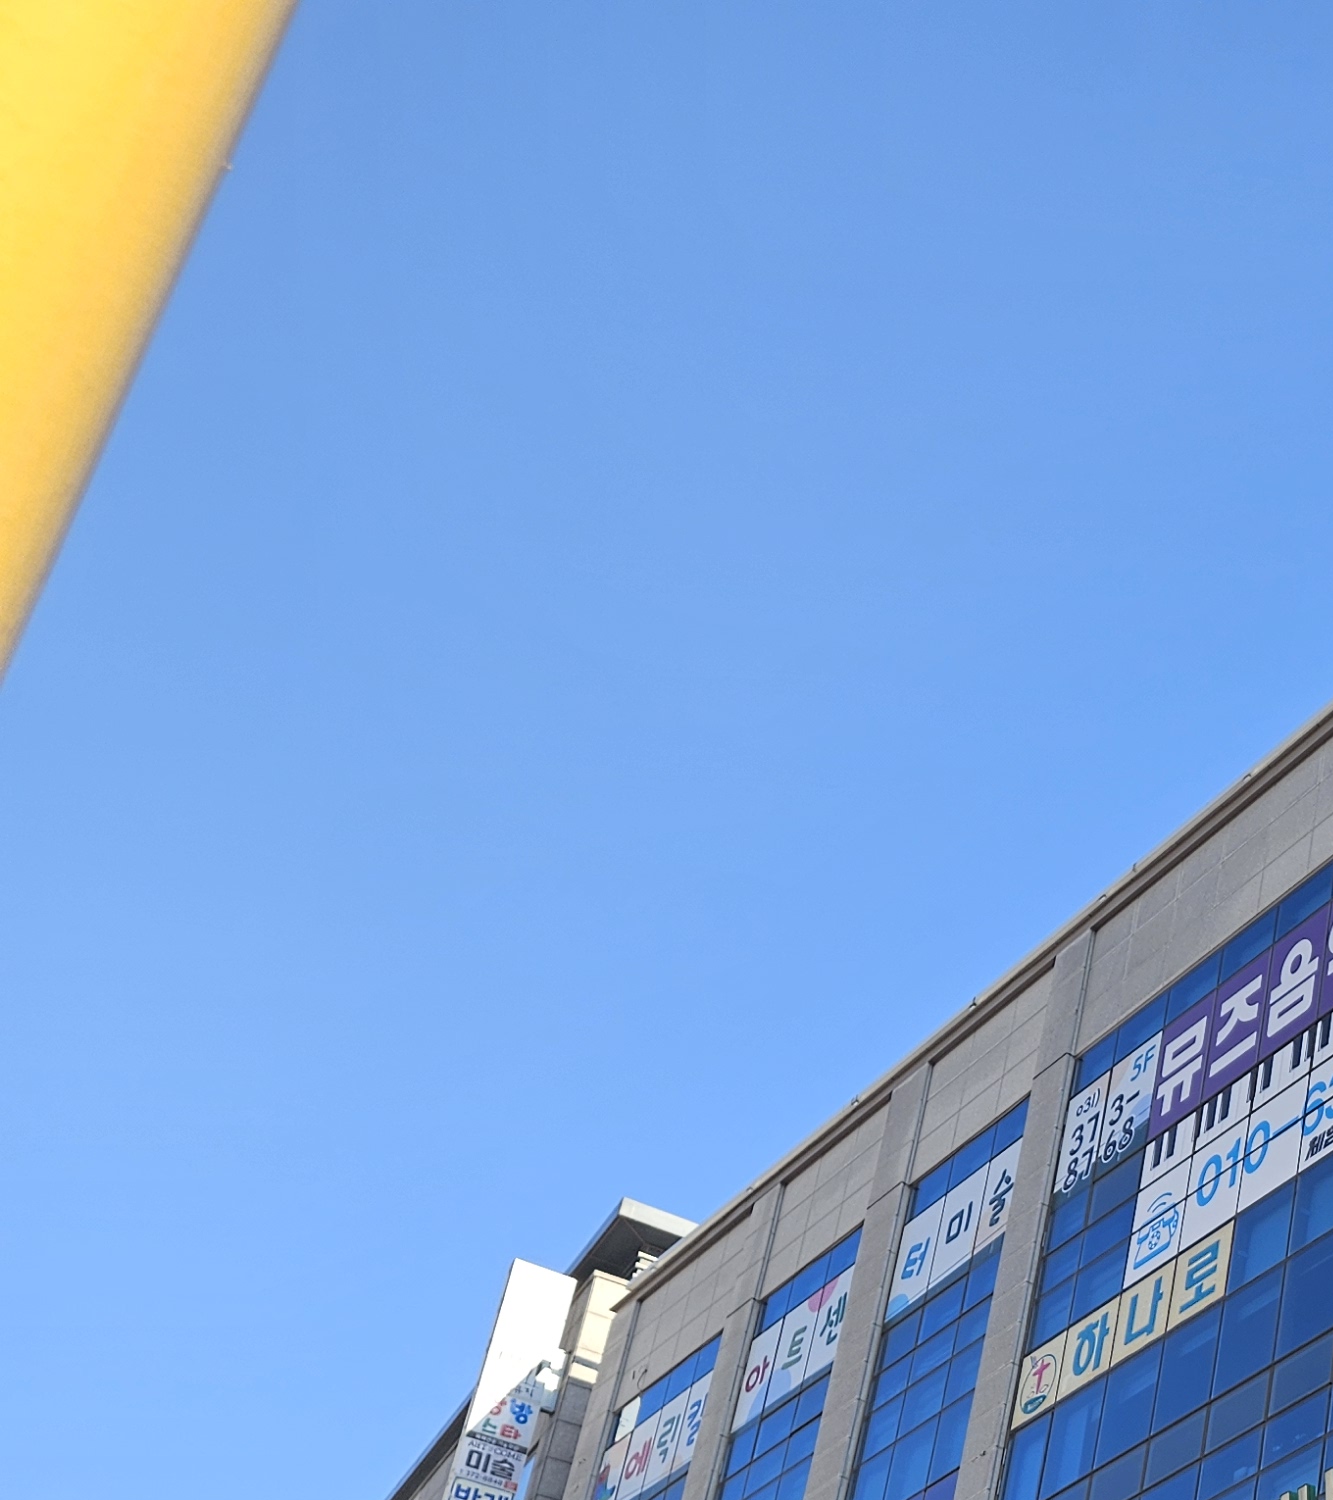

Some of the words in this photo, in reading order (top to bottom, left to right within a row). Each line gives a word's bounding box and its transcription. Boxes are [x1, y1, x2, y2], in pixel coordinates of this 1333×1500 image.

[1130, 1043, 1157, 1082] 5F
[1071, 1238, 1222, 1378] 하나로
[465, 1449, 516, 1481] 미술
